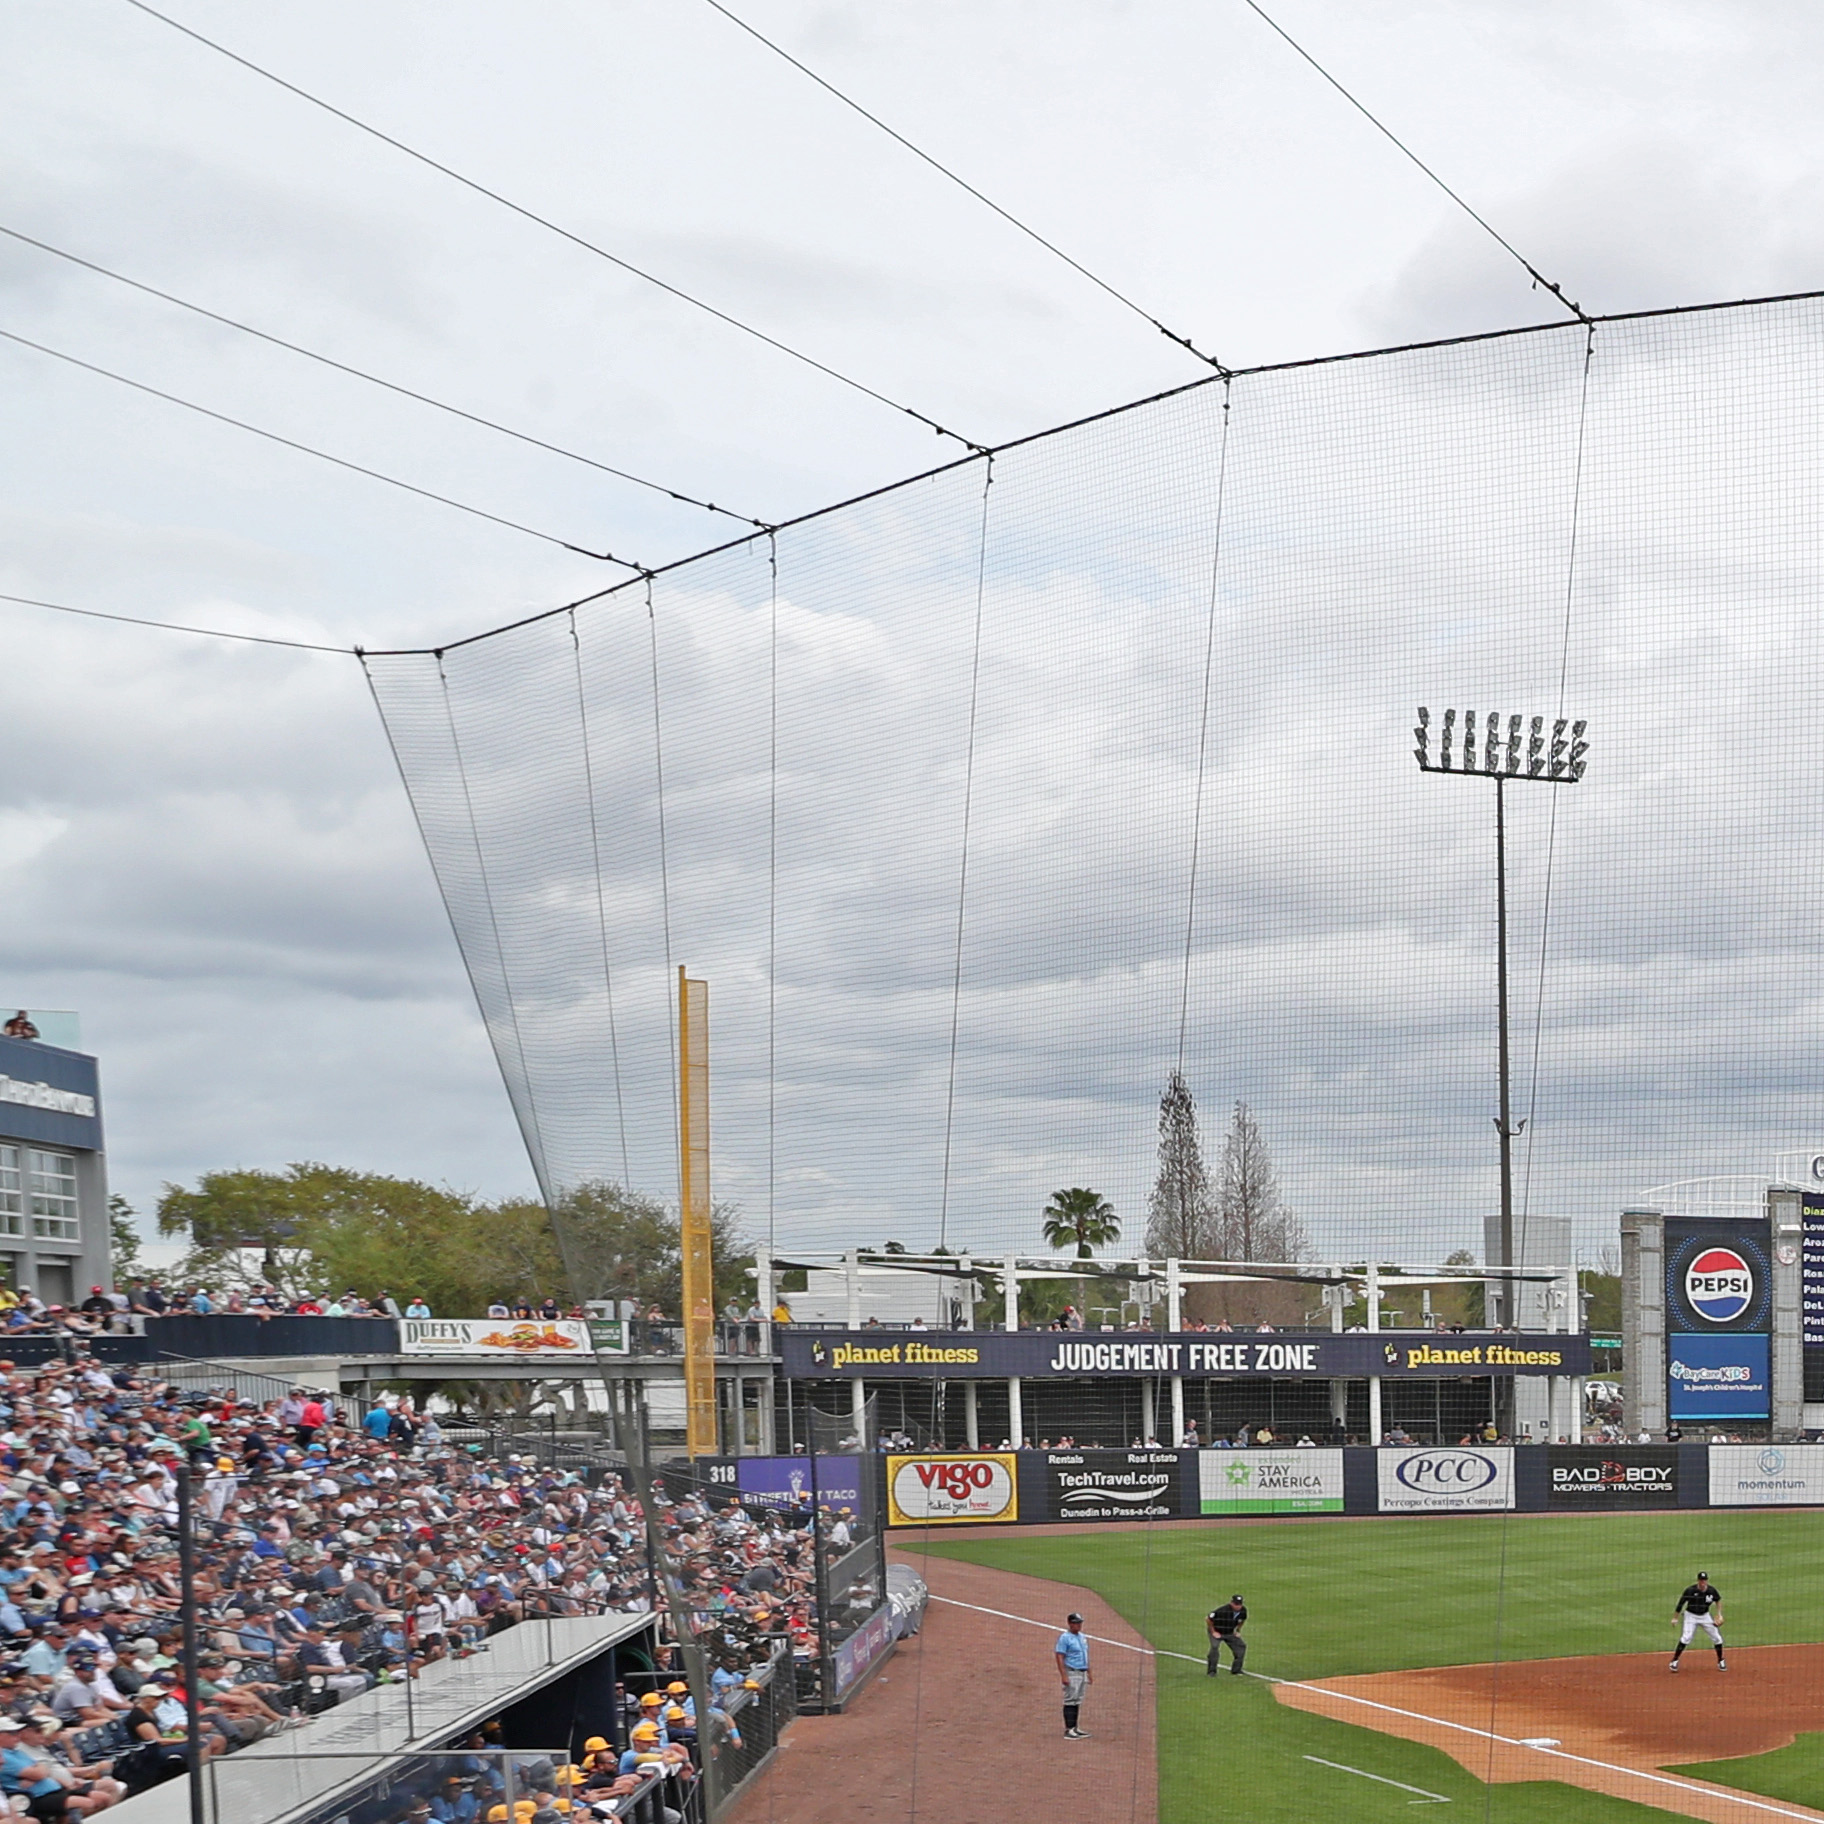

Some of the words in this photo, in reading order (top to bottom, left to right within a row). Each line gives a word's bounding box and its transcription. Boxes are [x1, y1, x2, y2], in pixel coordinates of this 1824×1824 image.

[1690, 1277, 1748, 1293] PEPSI
[832, 1343, 901, 1369] planet
[904, 1343, 979, 1364] fitness
[1051, 1343, 1182, 1371] JUDGEMENT
[1189, 1344, 1249, 1371] FREE
[1407, 1344, 1481, 1369] planet
[1485, 1345, 1562, 1366] fitness
[1048, 1453, 1085, 1465] Rentals
[1128, 1452, 1148, 1463] Real
[1149, 1453, 1178, 1463] Estate
[709, 1466, 737, 1483] 318
[1258, 1465, 1290, 1477] STAY
[1413, 1458, 1478, 1484] PCC
[1553, 1467, 1600, 1482] BAD
[1626, 1467, 1672, 1482] BOY
[1057, 1471, 1169, 1487] TechTravel.com
[1258, 1475, 1322, 1489] AMERICA
[1737, 1479, 1806, 1490] momentum
[1553, 1483, 1606, 1492] MOWERS
[1612, 1483, 1673, 1492] TRACTORS
[826, 1490, 857, 1500] TACO
[1424, 1496, 1465, 1508] Coatings
[1466, 1496, 1510, 1509] Company
[1060, 1507, 1100, 1517] Dunedin
[1113, 1506, 1170, 1517] Pass-a-Grille
